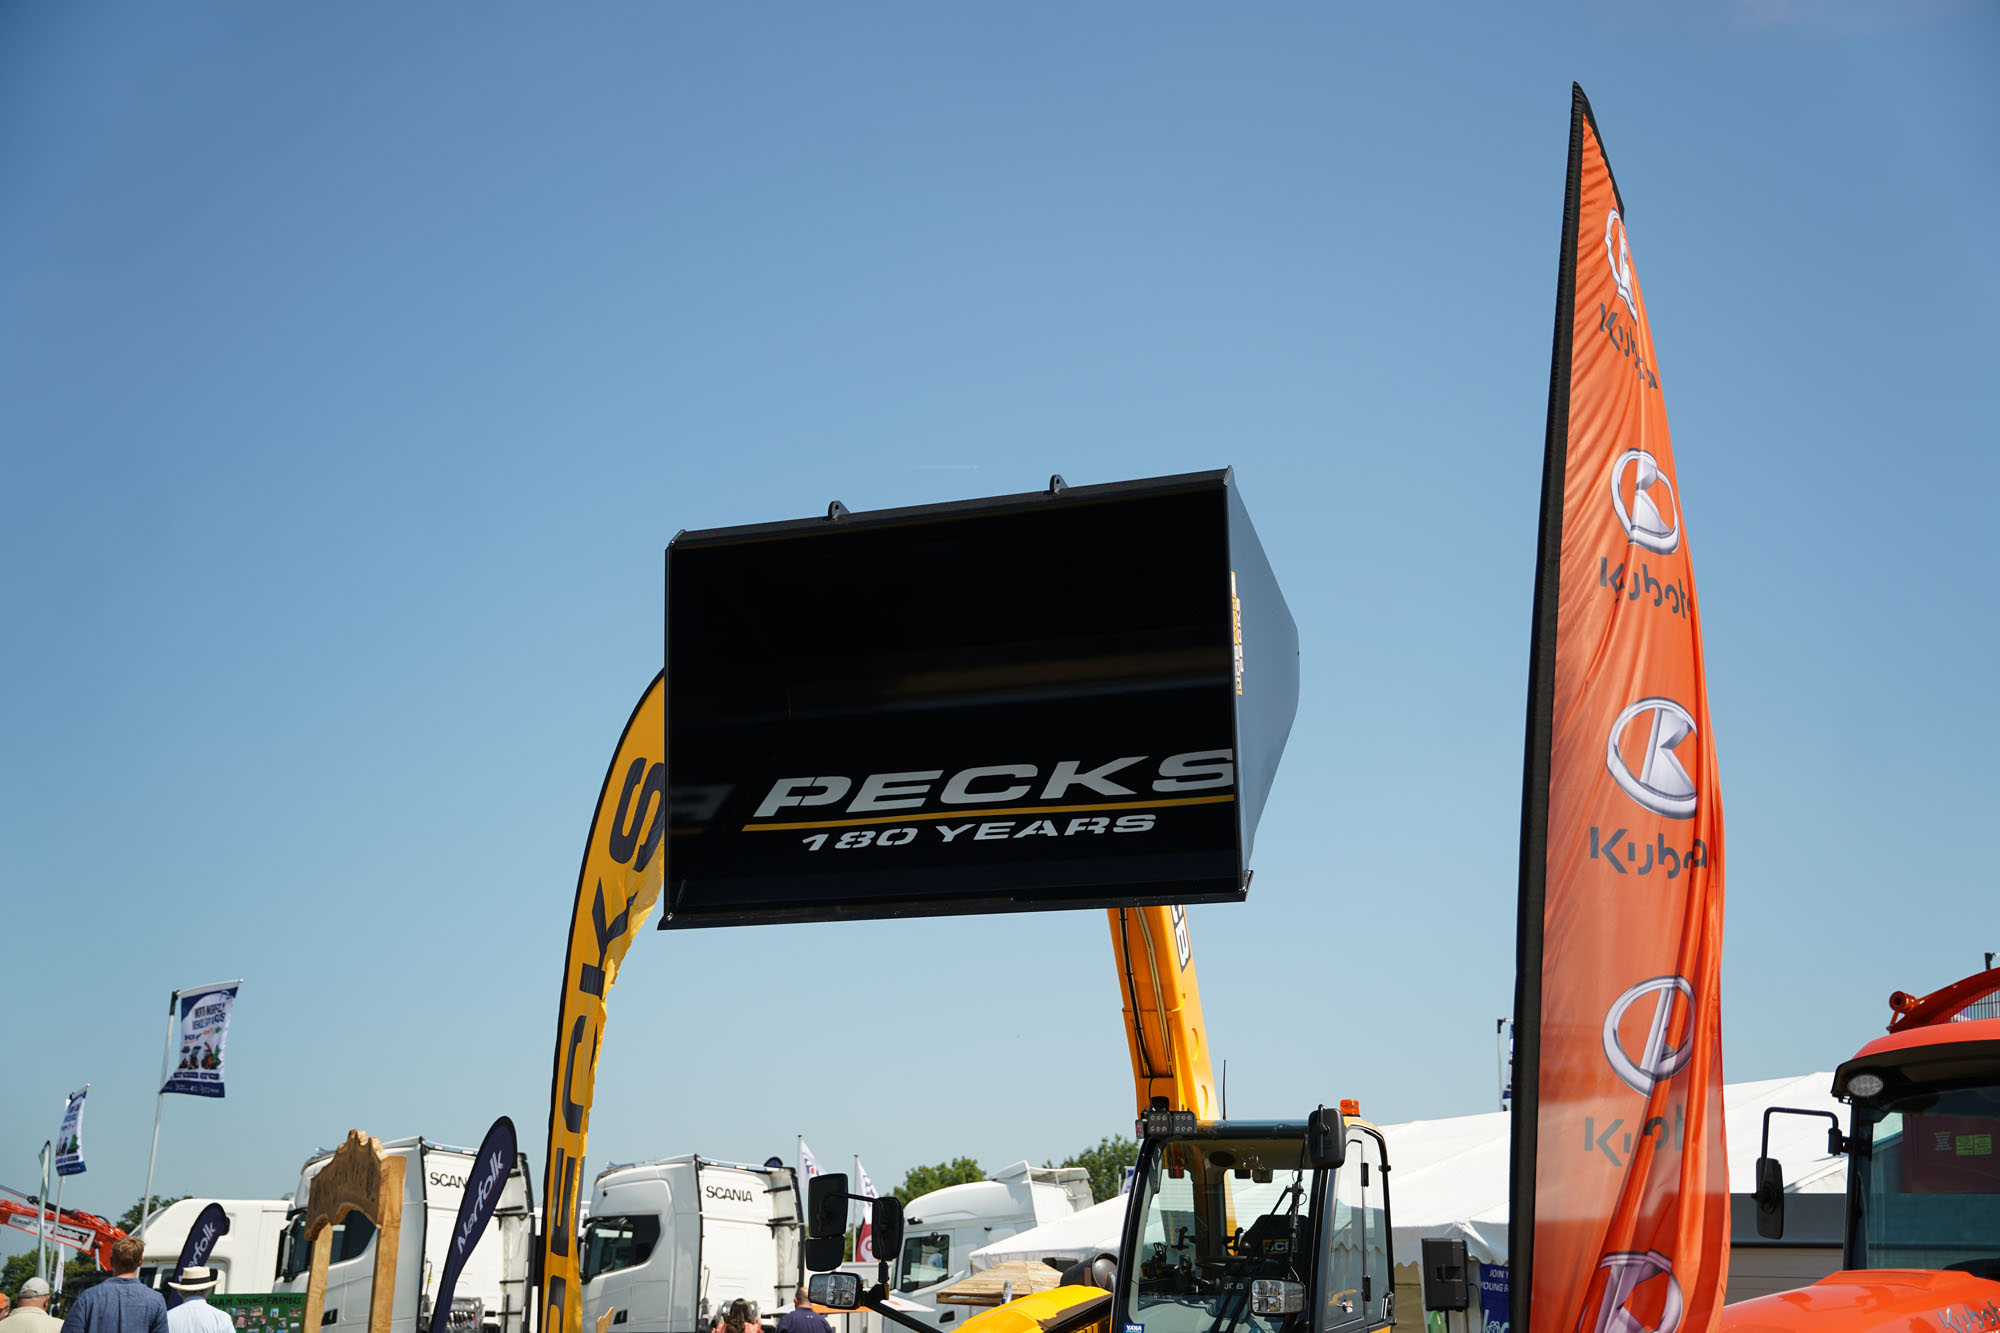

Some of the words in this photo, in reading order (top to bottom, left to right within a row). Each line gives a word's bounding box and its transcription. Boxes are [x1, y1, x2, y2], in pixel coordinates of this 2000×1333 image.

[752, 748, 1234, 817] PECKS
[802, 828, 918, 851] 180
[936, 814, 1156, 842] YEARS
[430, 1172, 468, 1188] SCAN
[706, 1185, 753, 1202] SCANIA
[457, 1150, 504, 1254] Norfolk
[183, 1221, 216, 1273] rfolk
[1489, 1269, 1504, 1279] JOIN
